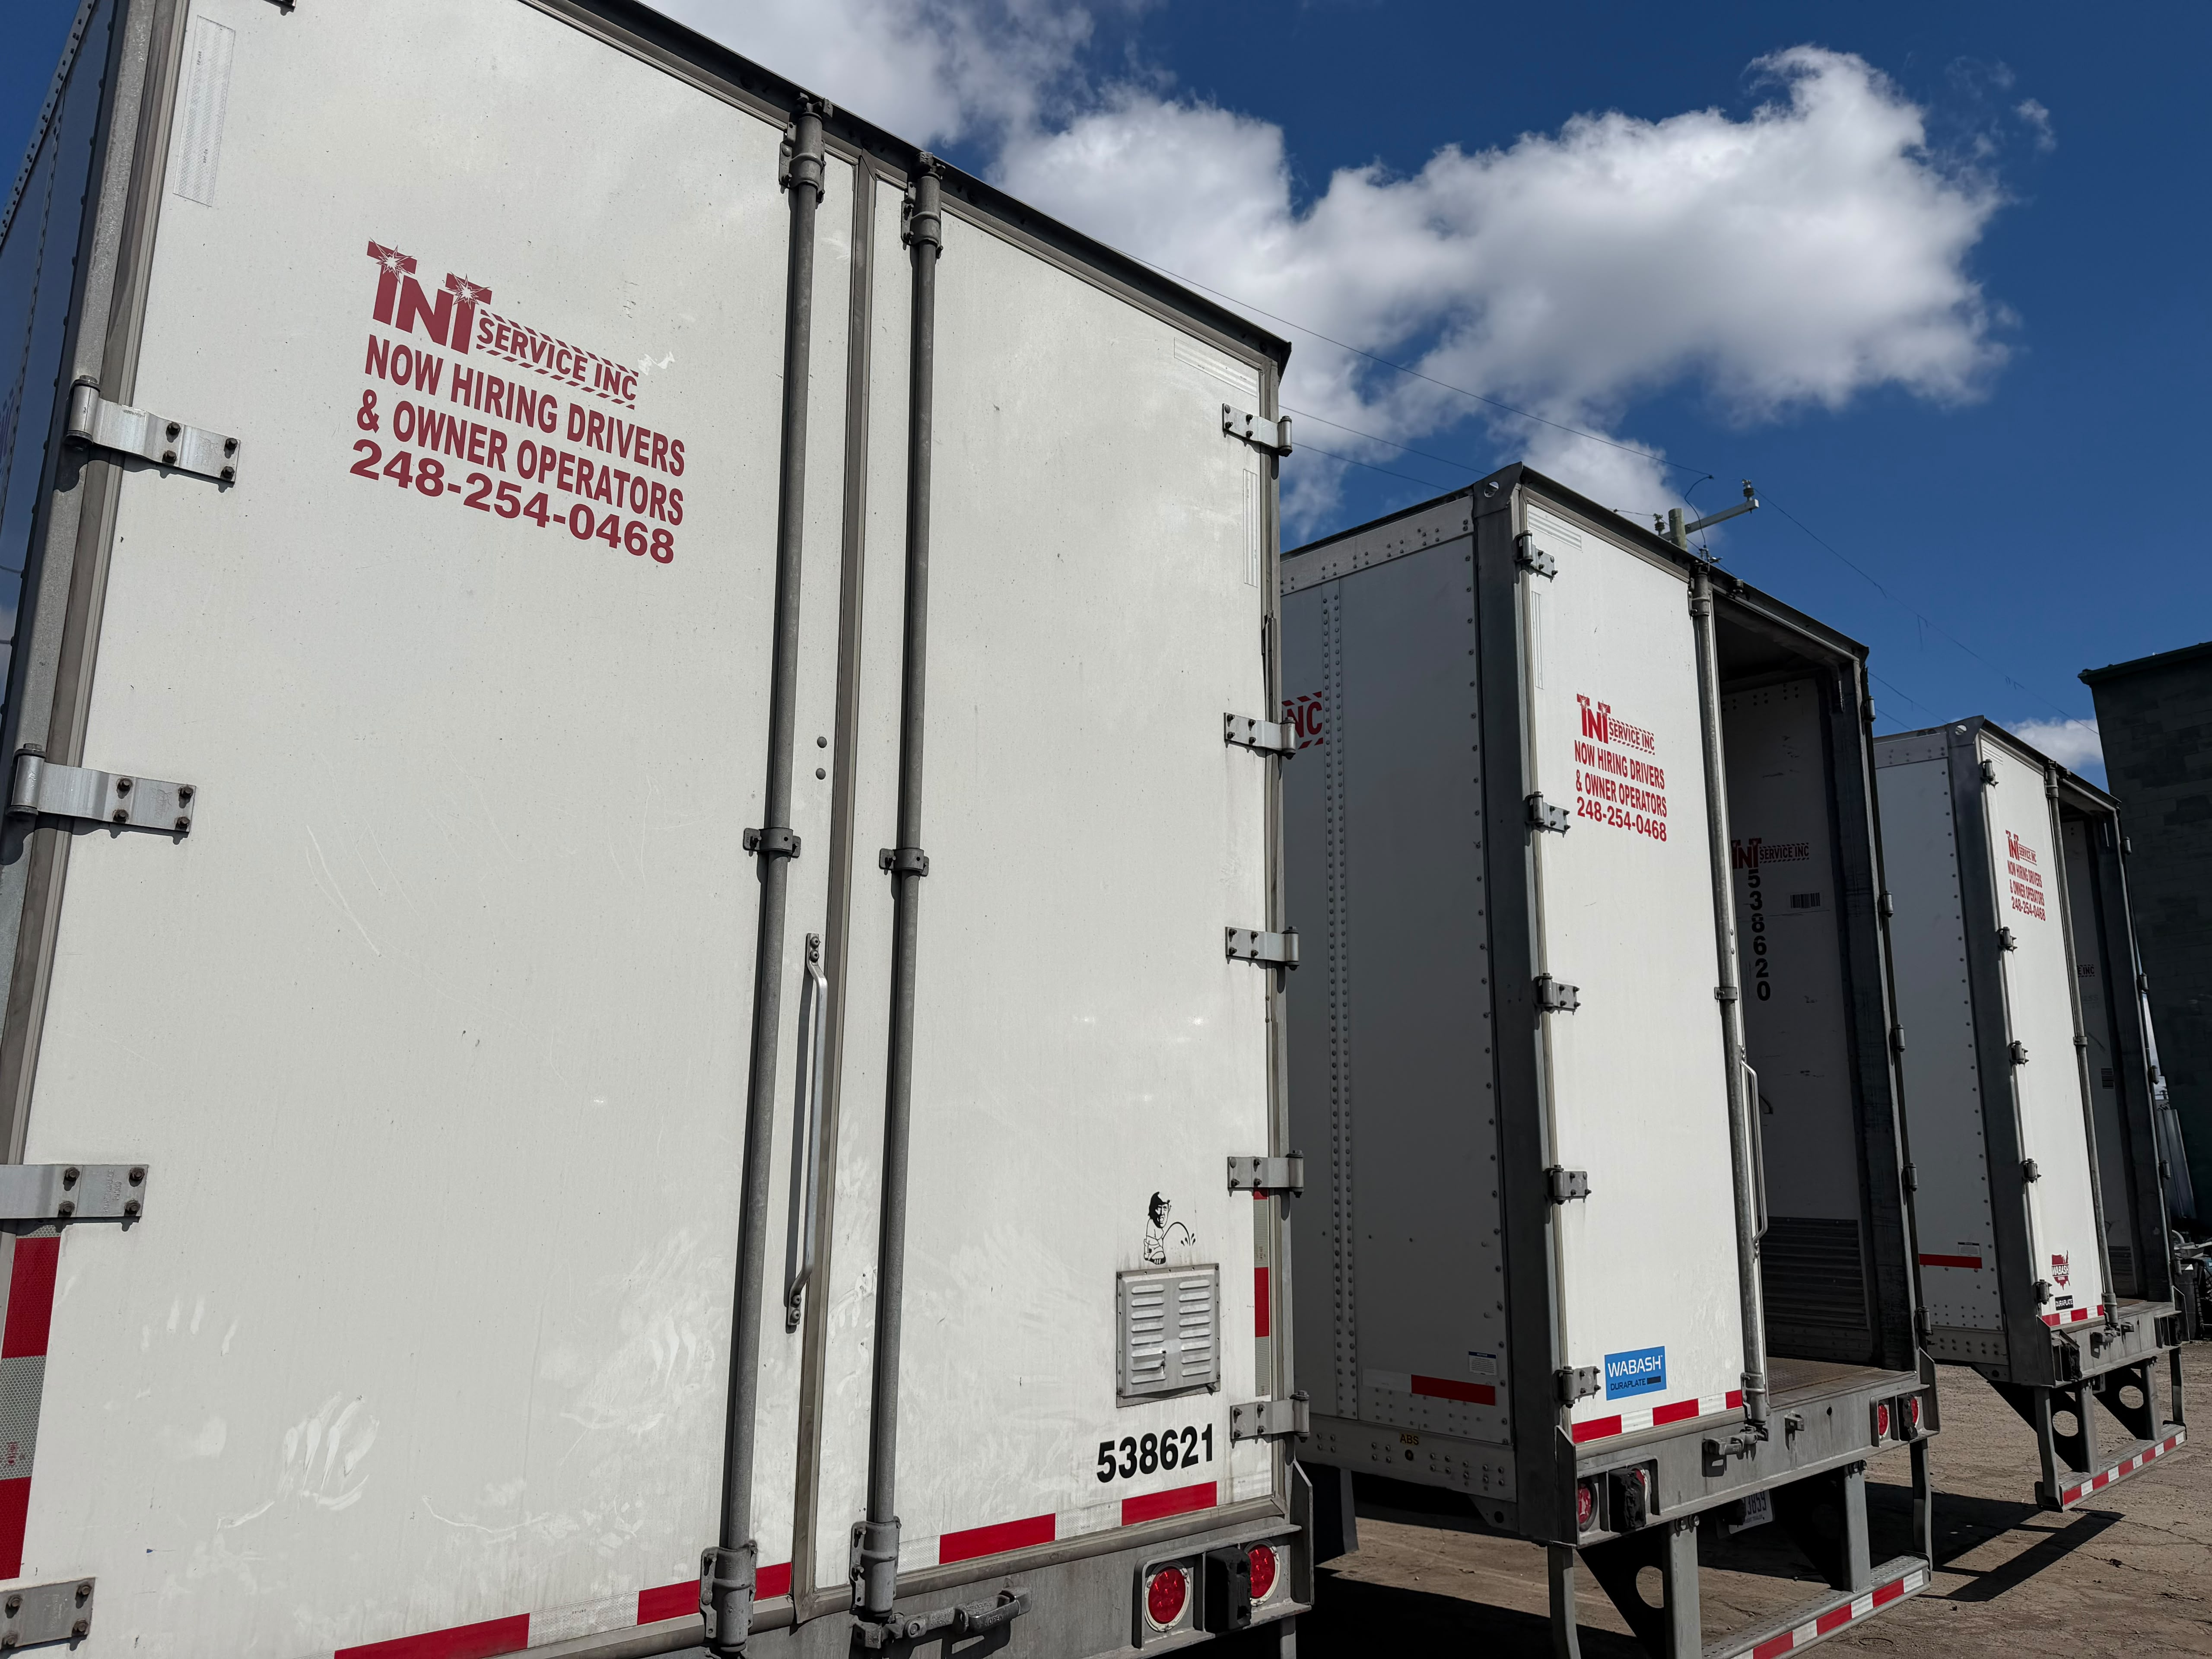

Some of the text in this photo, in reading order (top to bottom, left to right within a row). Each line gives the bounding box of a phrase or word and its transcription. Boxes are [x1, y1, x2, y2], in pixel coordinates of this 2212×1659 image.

[367, 240, 637, 401] TNT SERVICE INC
[365, 334, 685, 477] NOW HIRING DRIVERS
[356, 389, 684, 526] & OWNER OPERATORS
[350, 439, 674, 564] 248-254-0468
[1282, 701, 1322, 737] NC
[1577, 693, 1655, 750] TNT SERVICE INC
[1574, 740, 1665, 790] NOW HIRING DRIVERS
[1576, 769, 1667, 818] & OWNER OPERATORS
[1577, 796, 1667, 842] 248-254-0468
[1759, 848, 1793, 860] SERVICE
[1795, 845, 1809, 857] INC
[2012, 896, 2045, 921] 248-254-0468
[1748, 869, 1770, 1001] 538620
[2083, 966, 2094, 975] INC
[2052, 1265, 2069, 1276] WABASH
[2055, 1299, 2073, 1307] DURAPLATE
[1608, 1355, 1661, 1378] WABASH
[1611, 1378, 1646, 1391] DURAPLATE
[1096, 1423, 1213, 1483] 538621
[1400, 1434, 1419, 1445] ABS
[988, 1614, 1003, 1624] OPEN
